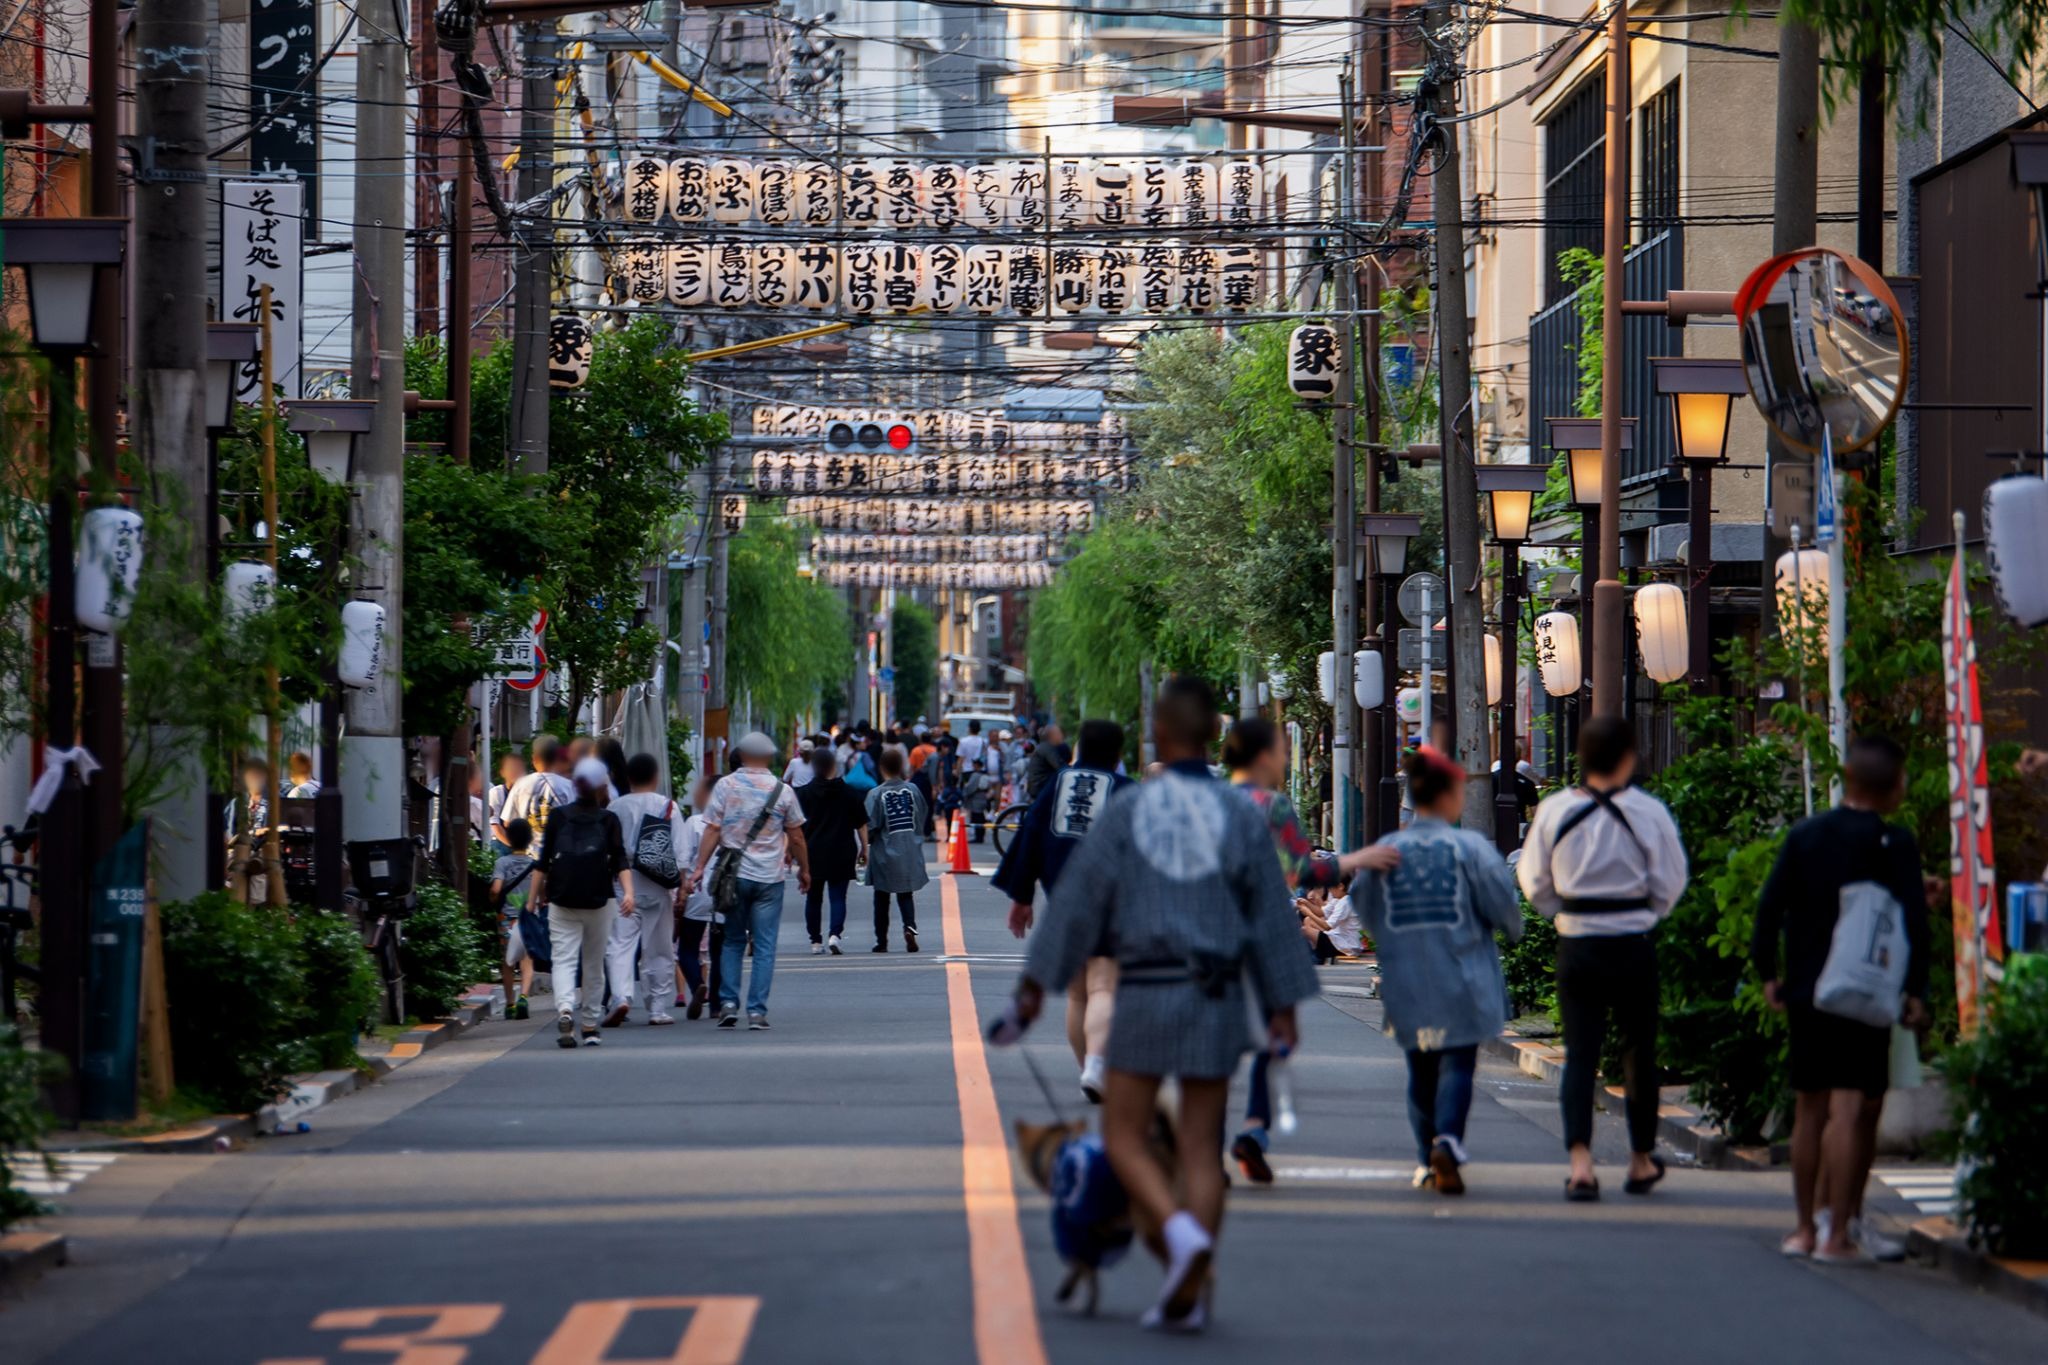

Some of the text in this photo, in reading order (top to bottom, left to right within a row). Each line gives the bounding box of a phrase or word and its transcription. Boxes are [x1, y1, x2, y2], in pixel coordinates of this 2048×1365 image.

[676, 161, 705, 217] おかめ
[802, 164, 833, 222] くろちゃん
[888, 167, 918, 224] あさひ
[931, 167, 959, 226] あさひ
[1010, 168, 1045, 226] 都鳥
[1095, 177, 1128, 224] 一直
[1141, 167, 1170, 227] とり幸
[245, 189, 282, 269] そば処
[718, 243, 746, 303] 鳥せん
[798, 246, 834, 303] サバ
[884, 245, 916, 307] 小宮
[1055, 249, 1085, 306] 勝山
[1142, 247, 1170, 308] 佐久良
[1223, 249, 1255, 306] 二葉
[1539, 618, 1557, 664] 仲見世
